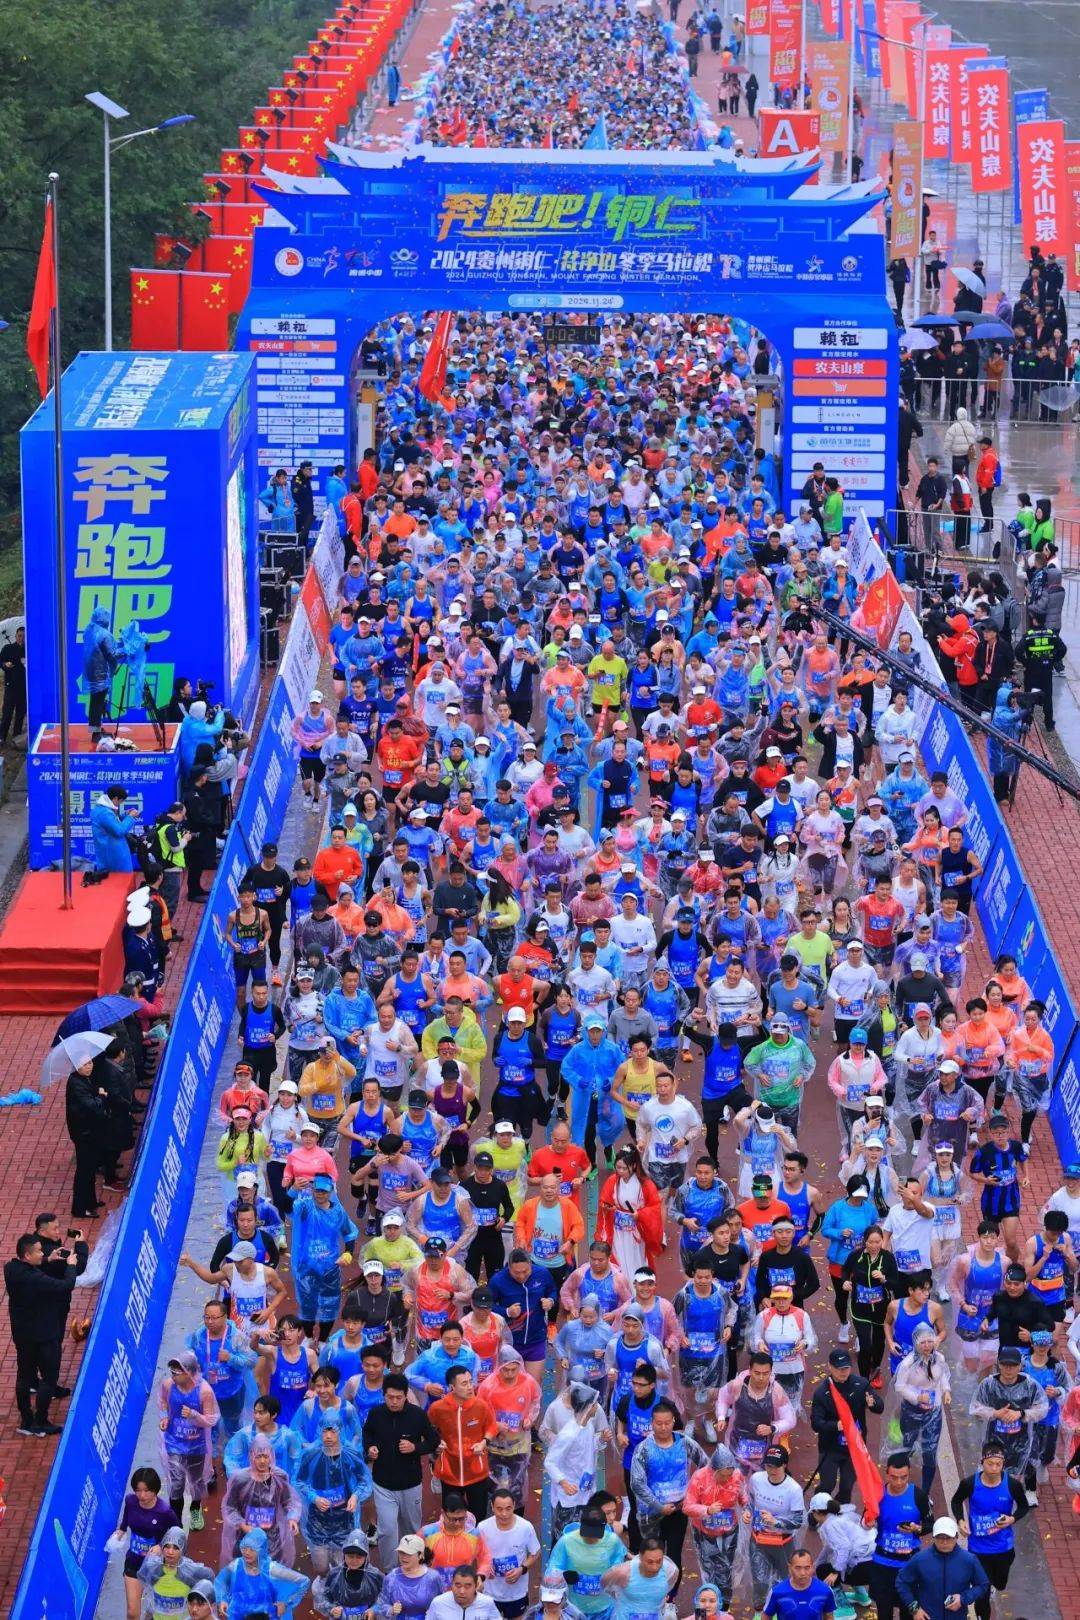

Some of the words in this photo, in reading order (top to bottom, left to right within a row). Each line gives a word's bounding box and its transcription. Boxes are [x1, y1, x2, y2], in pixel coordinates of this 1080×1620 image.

[767, 119, 800, 153] A
[977, 83, 1002, 177] 农夫山泉
[1029, 137, 1058, 242] 农夫山泉
[815, 362, 865, 374] 农夫山泉
[125, 1229, 159, 1348] 江口县人民政府
[92, 1338, 132, 1472] 贵州省田径协会
